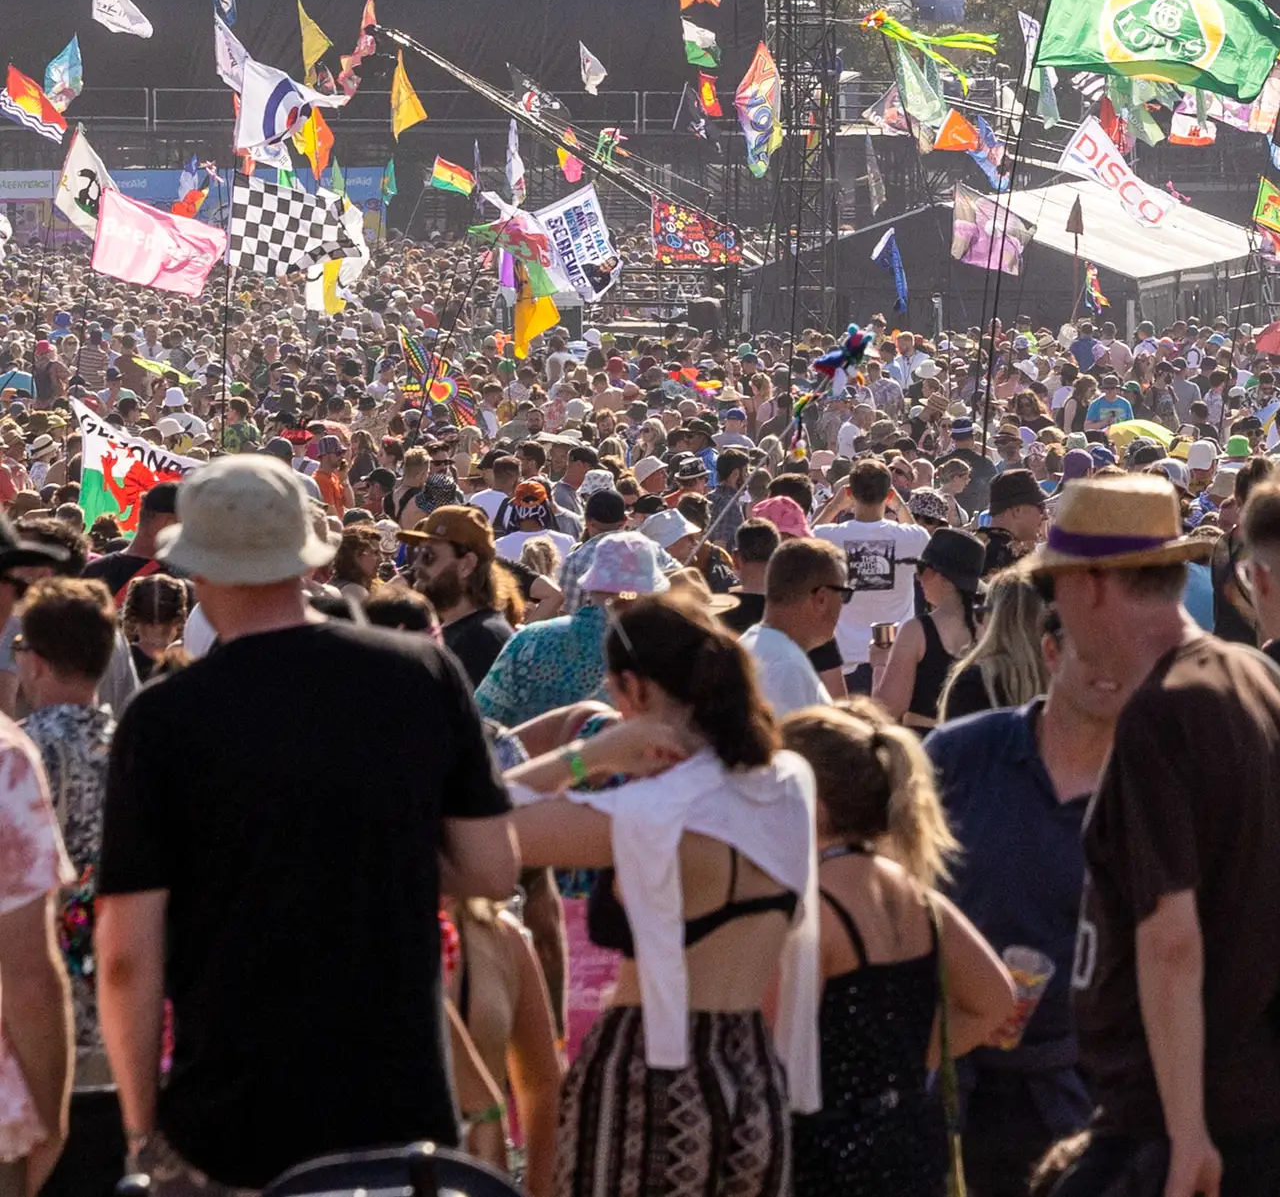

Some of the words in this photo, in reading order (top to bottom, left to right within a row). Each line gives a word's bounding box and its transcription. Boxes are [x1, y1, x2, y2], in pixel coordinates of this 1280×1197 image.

[1116, 10, 1204, 56] LOTUS
[1074, 132, 1165, 225] DISCO
[547, 216, 588, 289] SCREWE
[583, 233, 595, 253] FIX
